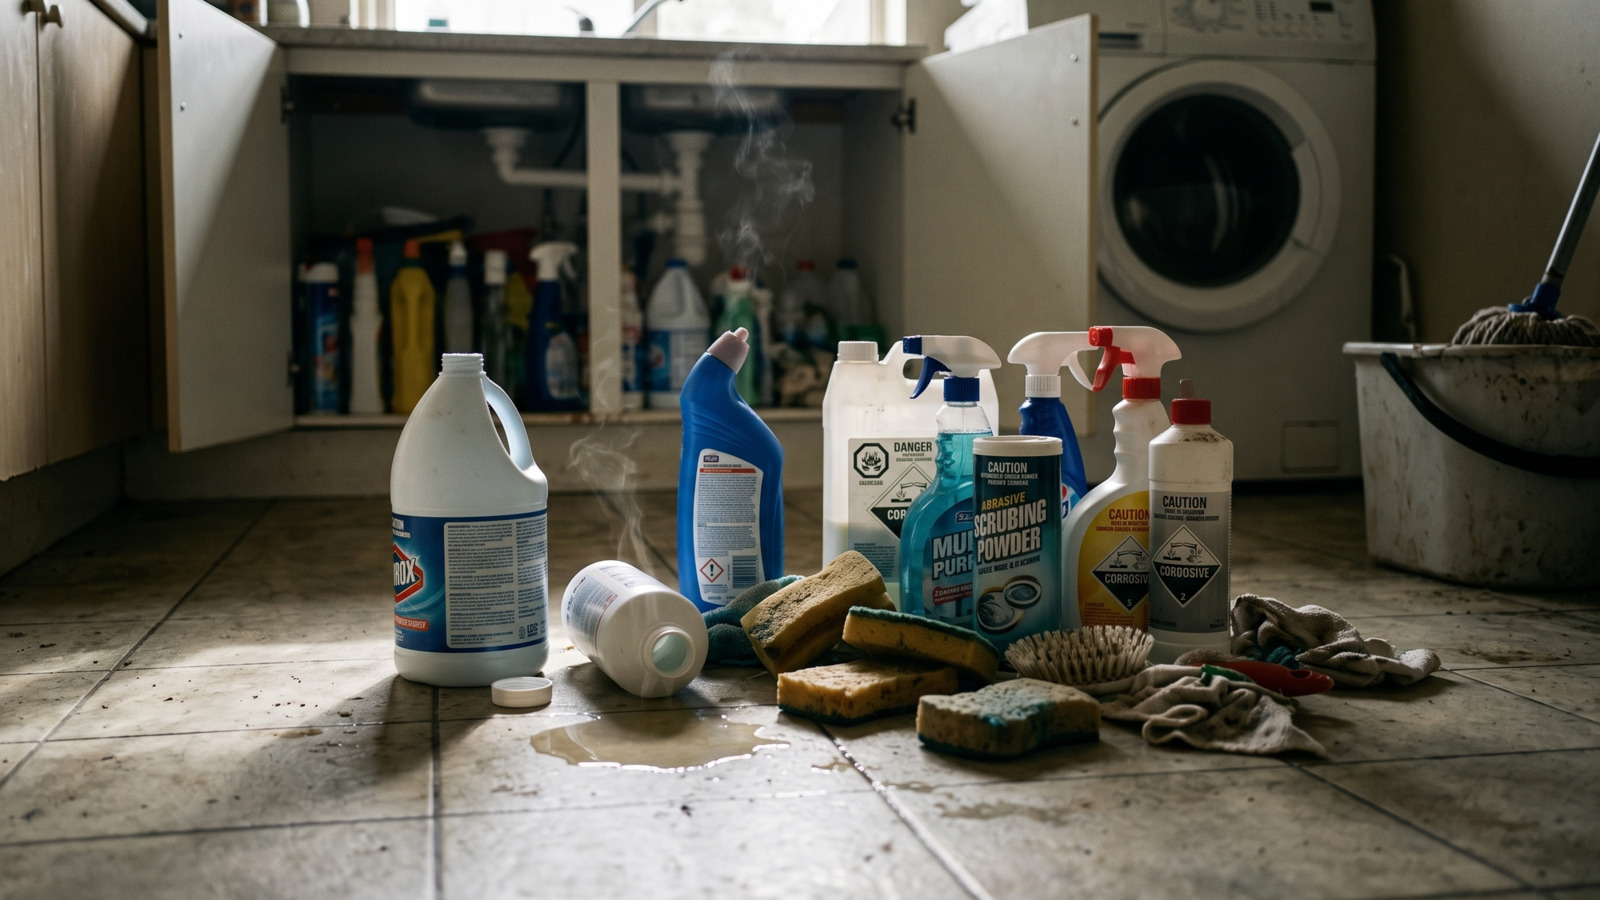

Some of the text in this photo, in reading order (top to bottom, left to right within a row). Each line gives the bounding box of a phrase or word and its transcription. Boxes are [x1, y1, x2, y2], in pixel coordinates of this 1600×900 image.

[894, 442, 932, 452] DANGER
[988, 461, 1028, 473] CAUTION
[982, 491, 1026, 511] ABRASIVE
[1162, 496, 1207, 508] CAUTION
[974, 498, 1047, 538] SCRUBING
[977, 526, 1041, 562] POWDER
[1180, 593, 1186, 601] 2
